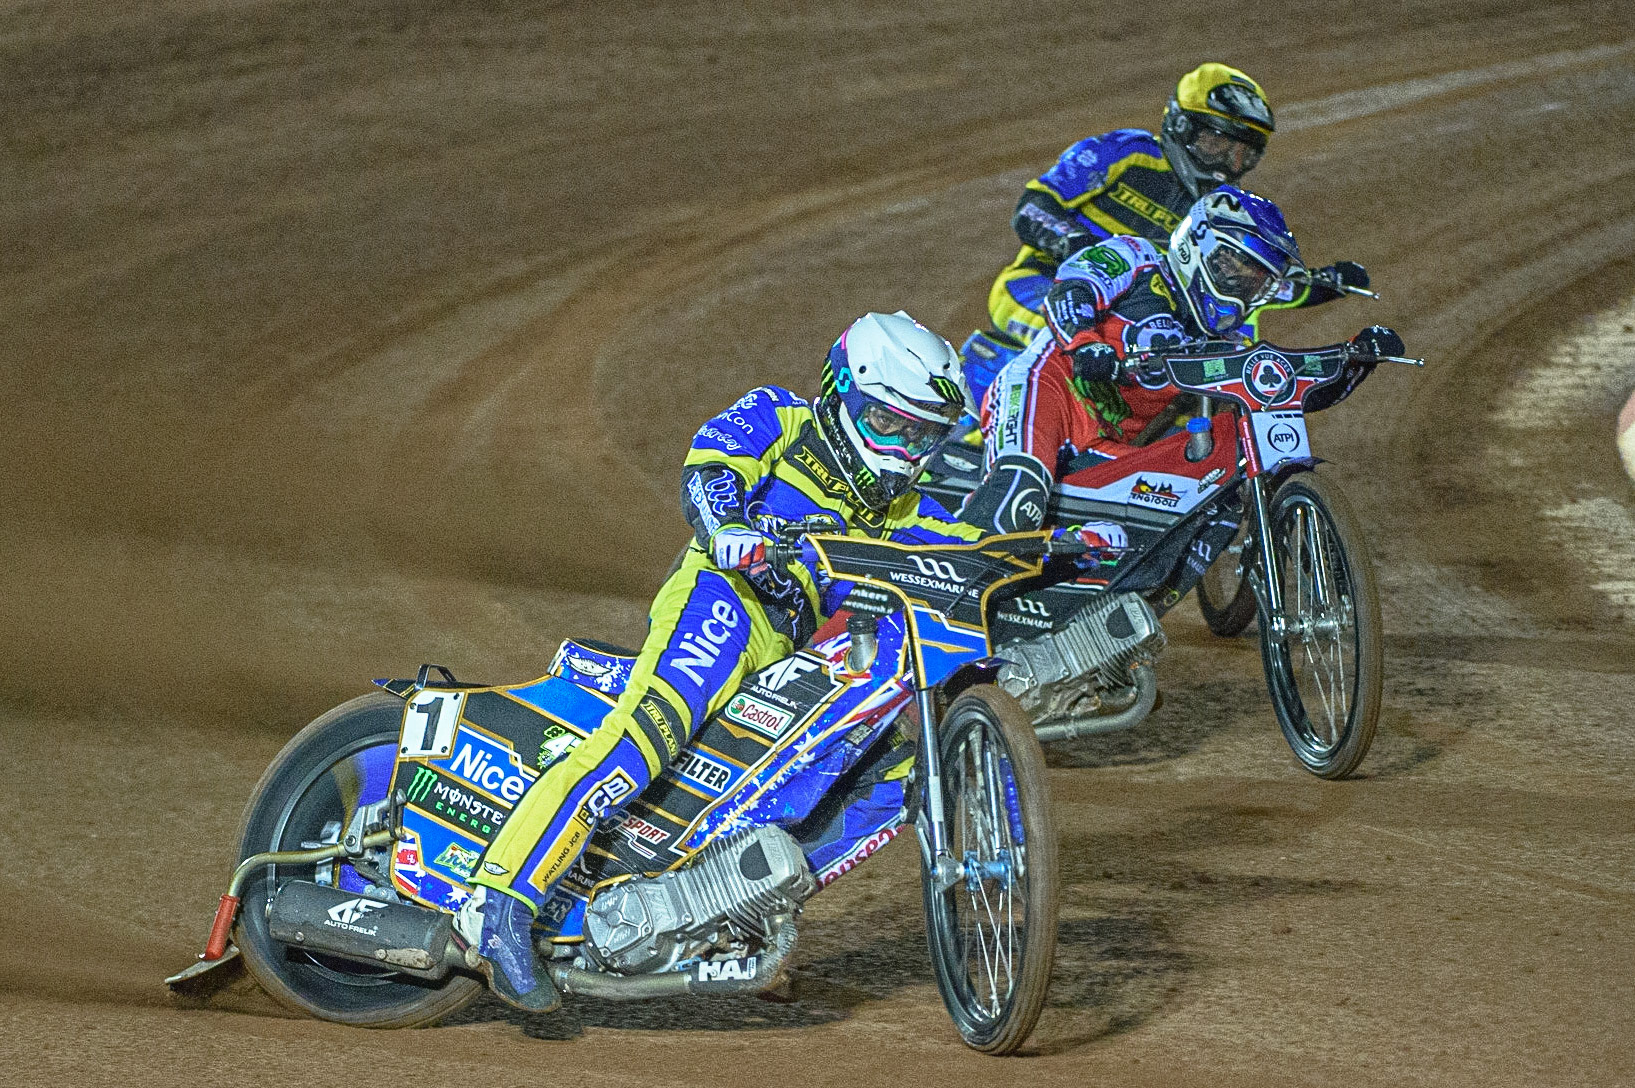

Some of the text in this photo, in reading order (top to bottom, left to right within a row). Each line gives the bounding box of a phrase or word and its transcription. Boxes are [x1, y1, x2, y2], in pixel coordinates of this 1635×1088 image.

[1245, 356, 1259, 374] BELLE
[1276, 355, 1291, 373] ACES
[1273, 433, 1295, 443] ATPI
[669, 599, 738, 688] Nice
[750, 685, 773, 699] AUTO
[416, 696, 443, 751] 1
[741, 704, 785, 731] Castrol
[450, 742, 525, 801] Nice
[671, 750, 729, 789] FILTER
[433, 781, 504, 825] MONSTE
[435, 801, 492, 834] ENERG
[622, 816, 668, 842] SPORT
[542, 847, 571, 883] WATLING
[570, 831, 581, 847] JCB
[323, 919, 349, 930] AUTO
